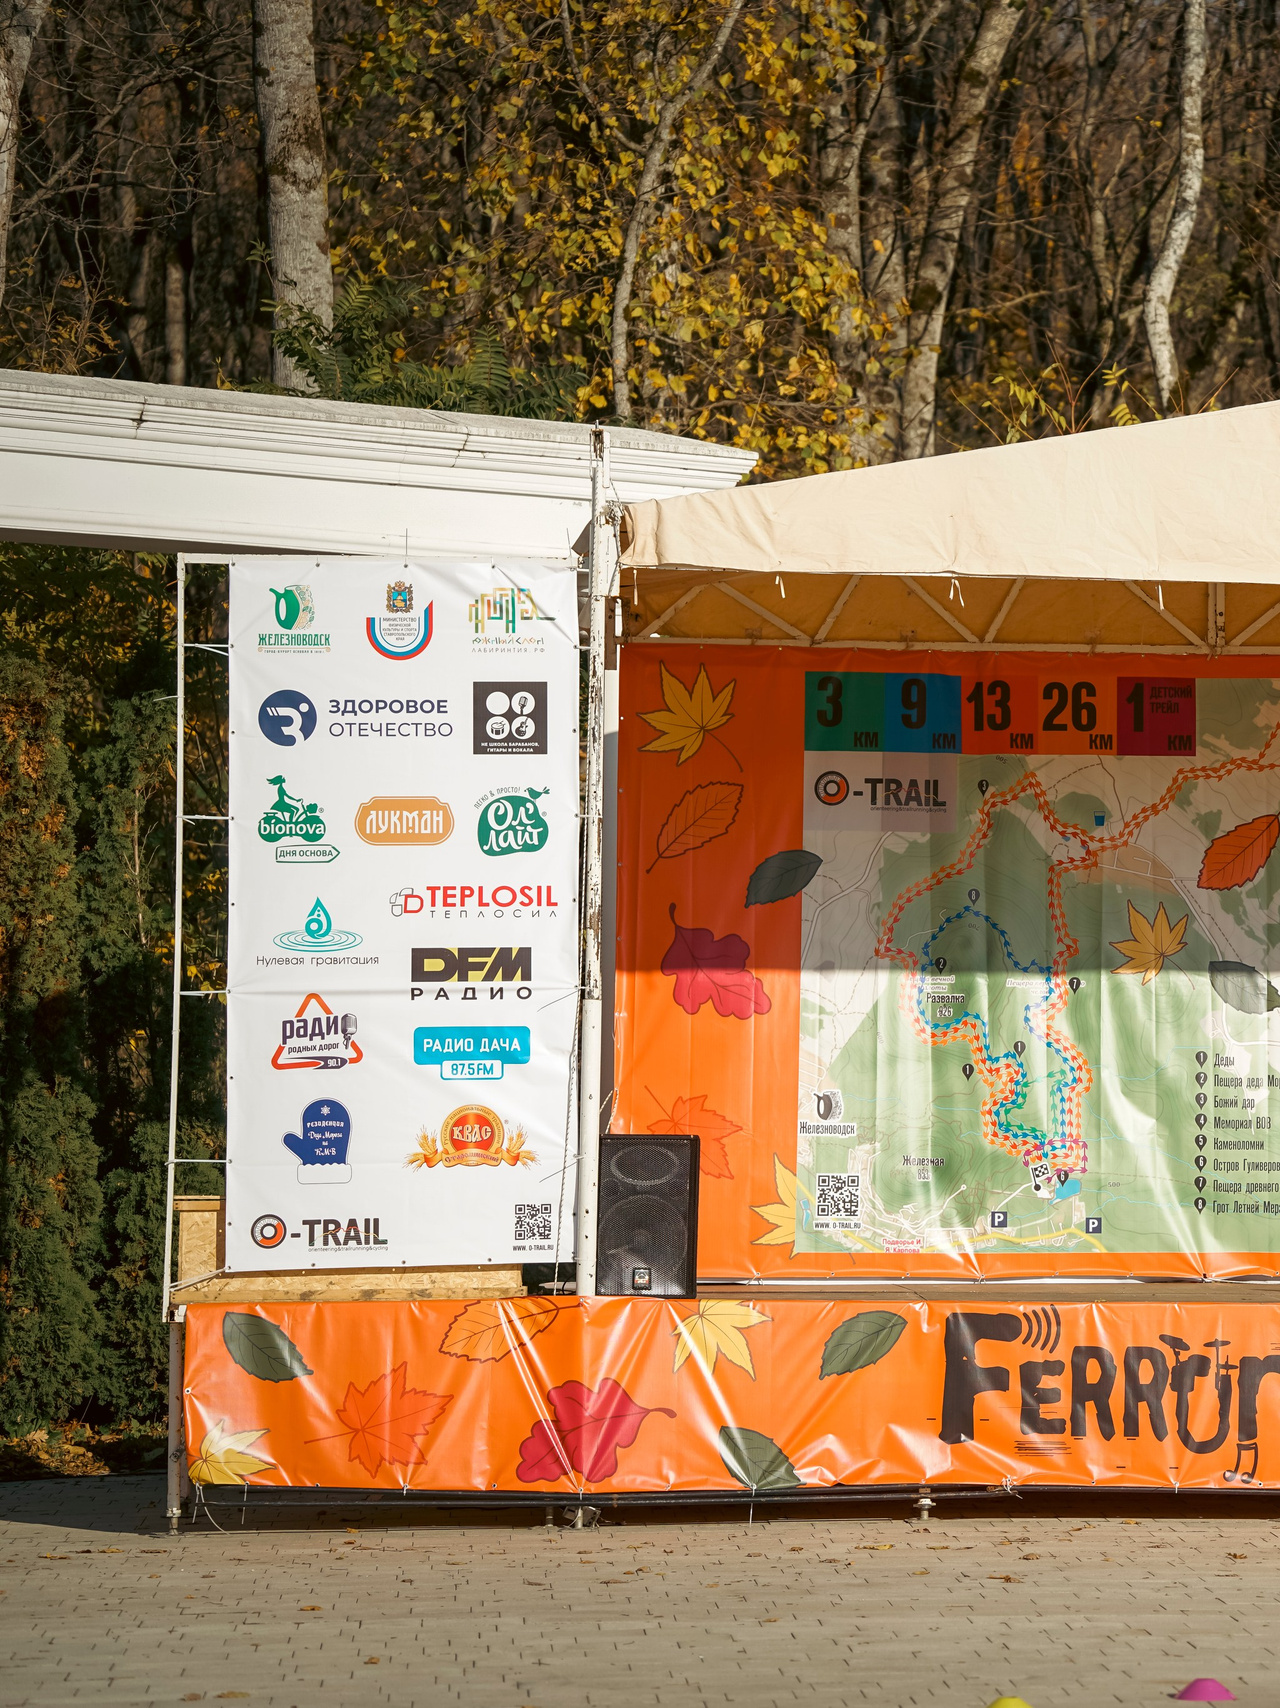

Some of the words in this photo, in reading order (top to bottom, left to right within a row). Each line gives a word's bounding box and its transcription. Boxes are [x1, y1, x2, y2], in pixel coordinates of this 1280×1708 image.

[258, 633, 331, 646] ЖЕЛЕЗНОВОДСК
[1150, 685, 1192, 698] ДЕТСКИЙ
[329, 699, 449, 716] ЗДОРОВОЕ
[817, 676, 843, 728] 3
[854, 732, 879, 748] КМ
[901, 678, 927, 730] 9
[932, 733, 956, 750] КМ
[1150, 701, 1179, 714] ТРЕЙЛ
[966, 680, 1011, 732] 13
[1010, 734, 1033, 750] КМ
[1042, 681, 1097, 732] 26
[1089, 734, 1113, 750] КМ
[1125, 682, 1145, 733] 1
[1168, 735, 1193, 751] КМ
[329, 722, 454, 737] ОТЕЧЕСТВО
[489, 790, 495, 798] &
[496, 786, 521, 795] ПРОСТО!
[814, 770, 947, 807] O-TRAIL
[260, 819, 325, 835] bionova
[278, 849, 297, 858] ДНЯ
[298, 848, 334, 857] ОСНОВА
[426, 885, 558, 907] TEPLOSIL
[430, 909, 557, 918] ТЕПЛОСИЛ
[256, 955, 305, 967] Нулевая
[311, 956, 379, 967] гравитация
[411, 947, 532, 982] DFM
[411, 987, 533, 1000] РАДИО
[926, 993, 965, 1004] Развалка
[288, 1045, 317, 1055] родных
[318, 1043, 340, 1052] дорог
[423, 1037, 475, 1053] РАДИО
[479, 1036, 521, 1053] ДАЧА
[327, 1058, 341, 1068] 90.1
[1214, 1053, 1235, 1066] Деды
[1214, 1074, 1243, 1088] Пещера
[1246, 1077, 1264, 1088] деда
[1214, 1096, 1238, 1108] Божий
[1242, 1099, 1255, 1110] дар
[799, 1121, 855, 1136] Железноводск
[1214, 1116, 1252, 1131] Мемориал
[1256, 1116, 1271, 1129] ВОВ
[452, 1124, 492, 1143] КВАС
[1213, 1138, 1265, 1151] Каменоломни
[902, 1155, 945, 1166] Железная
[1213, 1159, 1240, 1173] Остров
[1243, 1159, 1280, 1174] Гуливеров
[1213, 1180, 1242, 1194] Пещера
[1245, 1182, 1279, 1194] древнего
[1213, 1201, 1229, 1215] Грот
[1233, 1201, 1259, 1213] Летней
[251, 1213, 388, 1249] O-TRAIL
